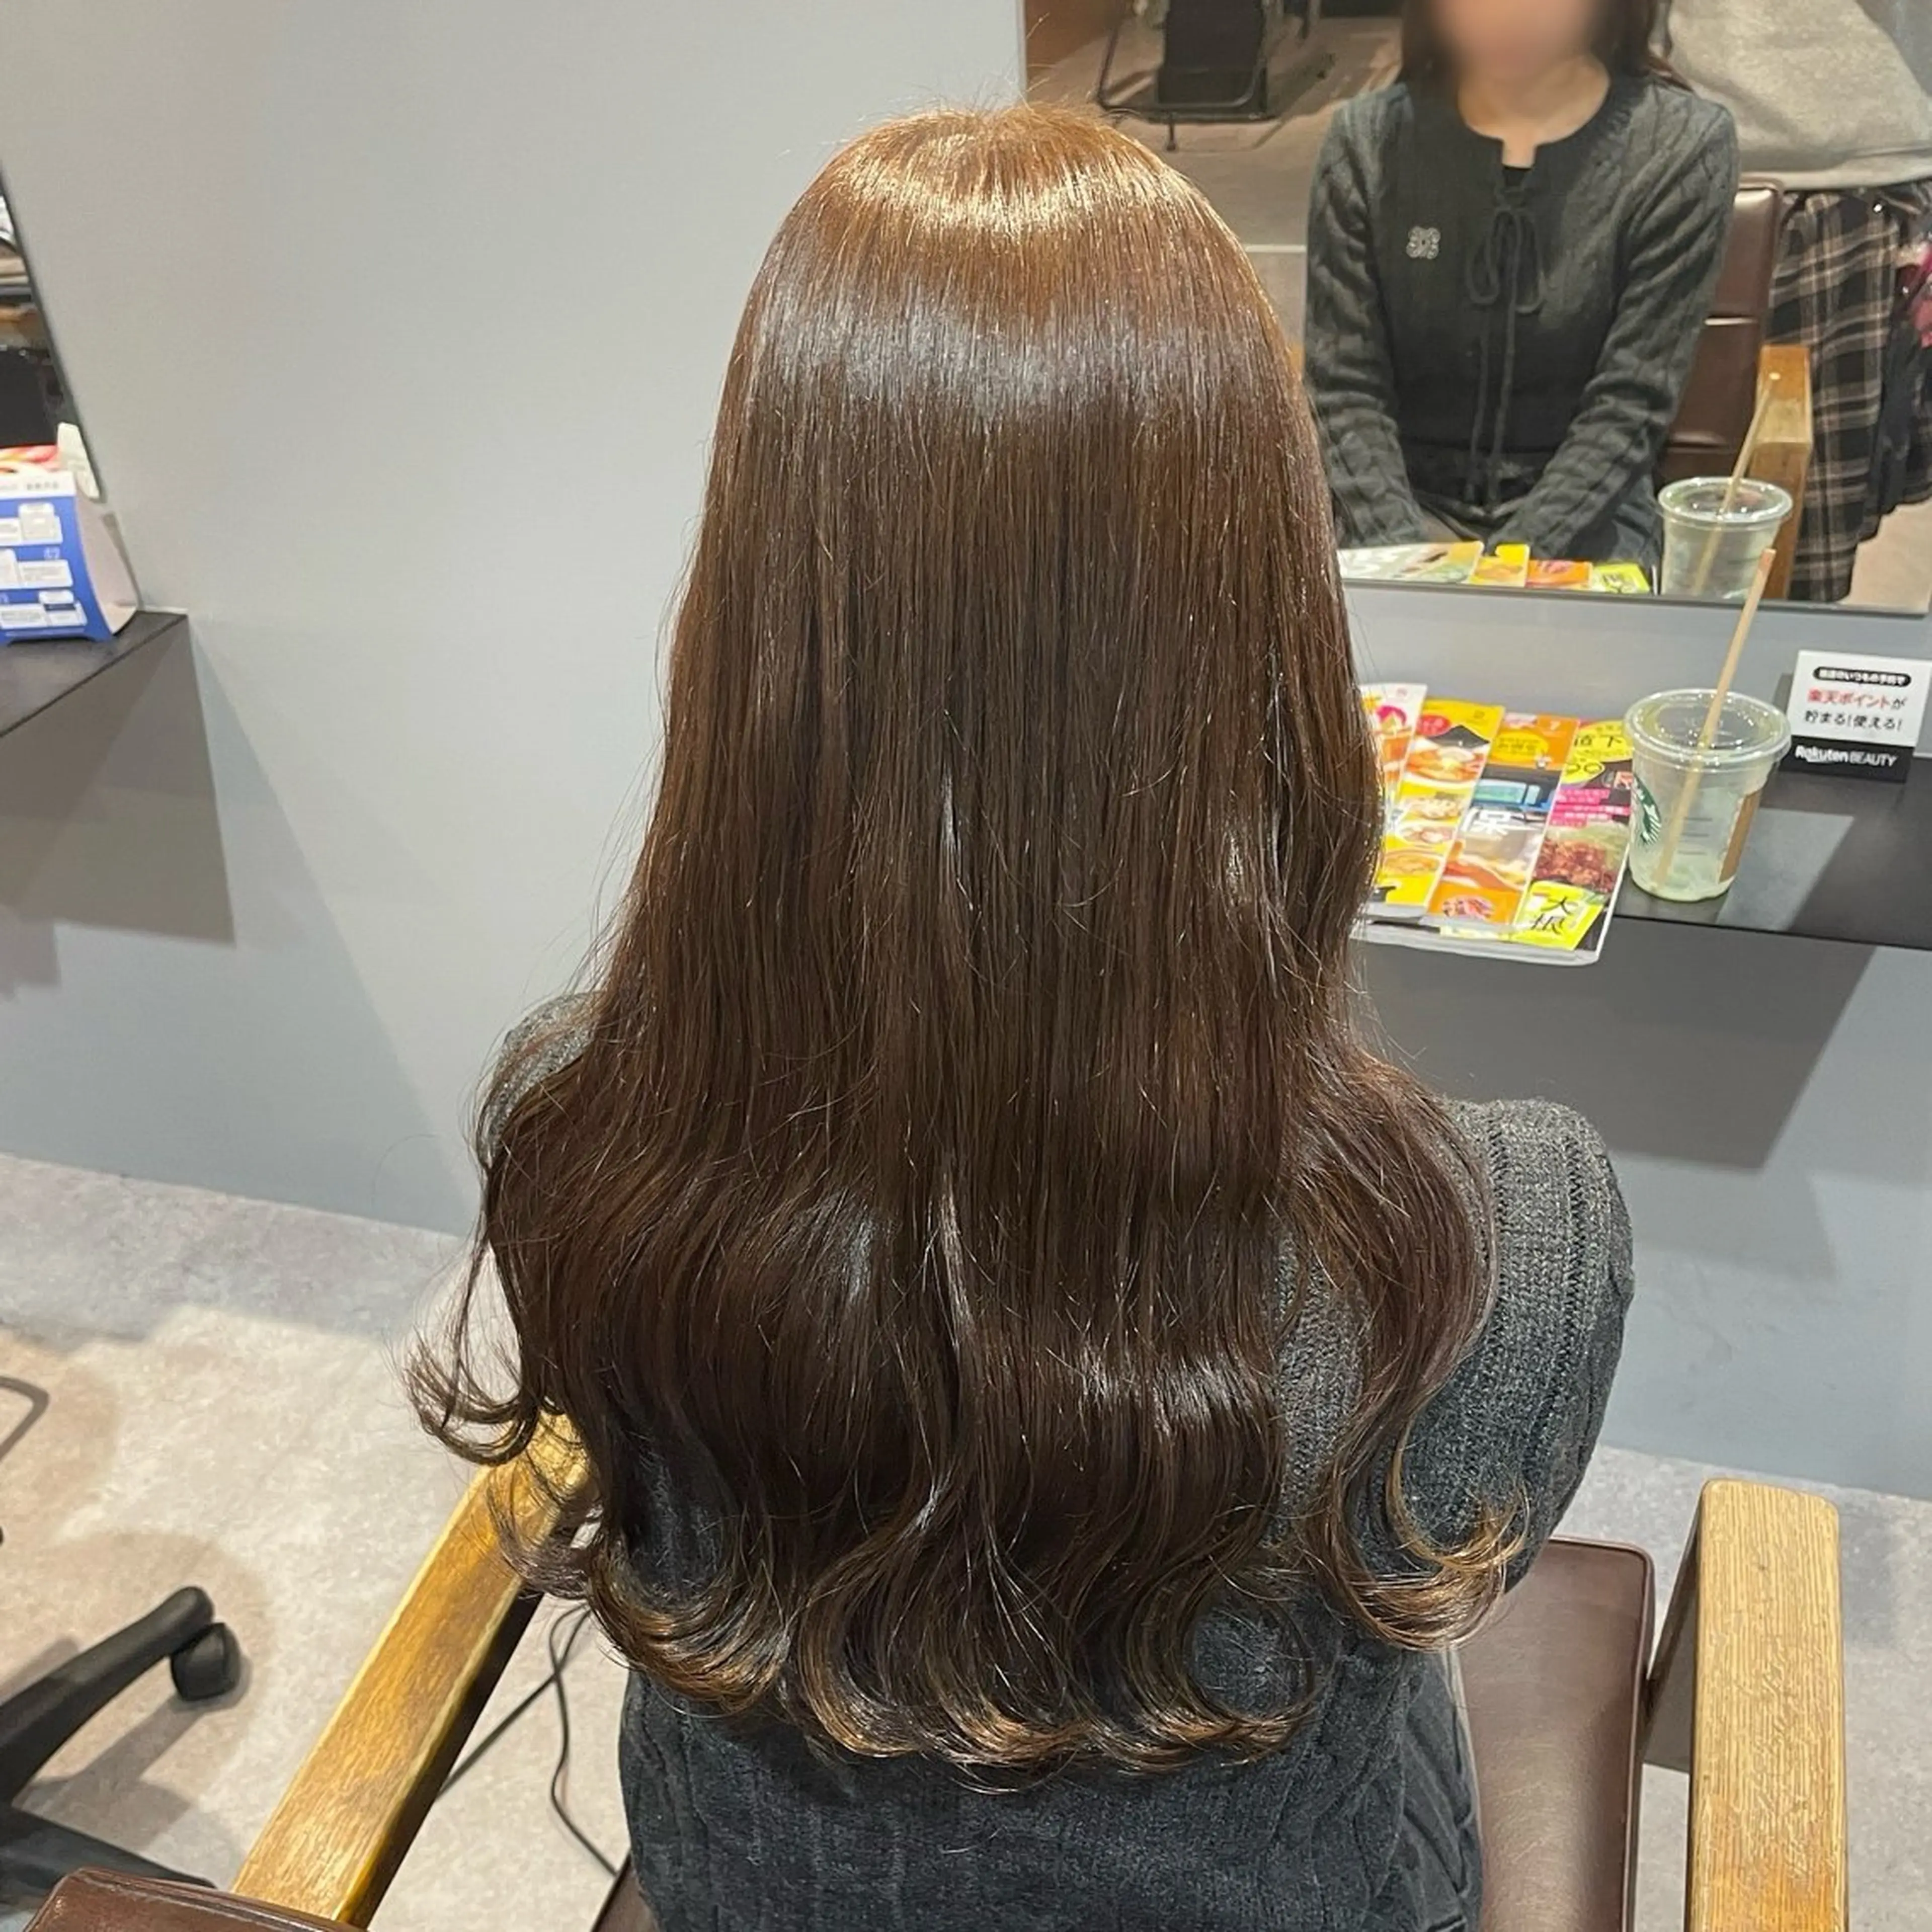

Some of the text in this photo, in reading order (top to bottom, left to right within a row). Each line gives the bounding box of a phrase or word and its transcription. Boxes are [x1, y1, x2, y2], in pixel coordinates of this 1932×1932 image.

[1808, 688, 1907, 709] 楽天ポイントが
[1795, 745, 1897, 767] Rakuten BEAUTY
